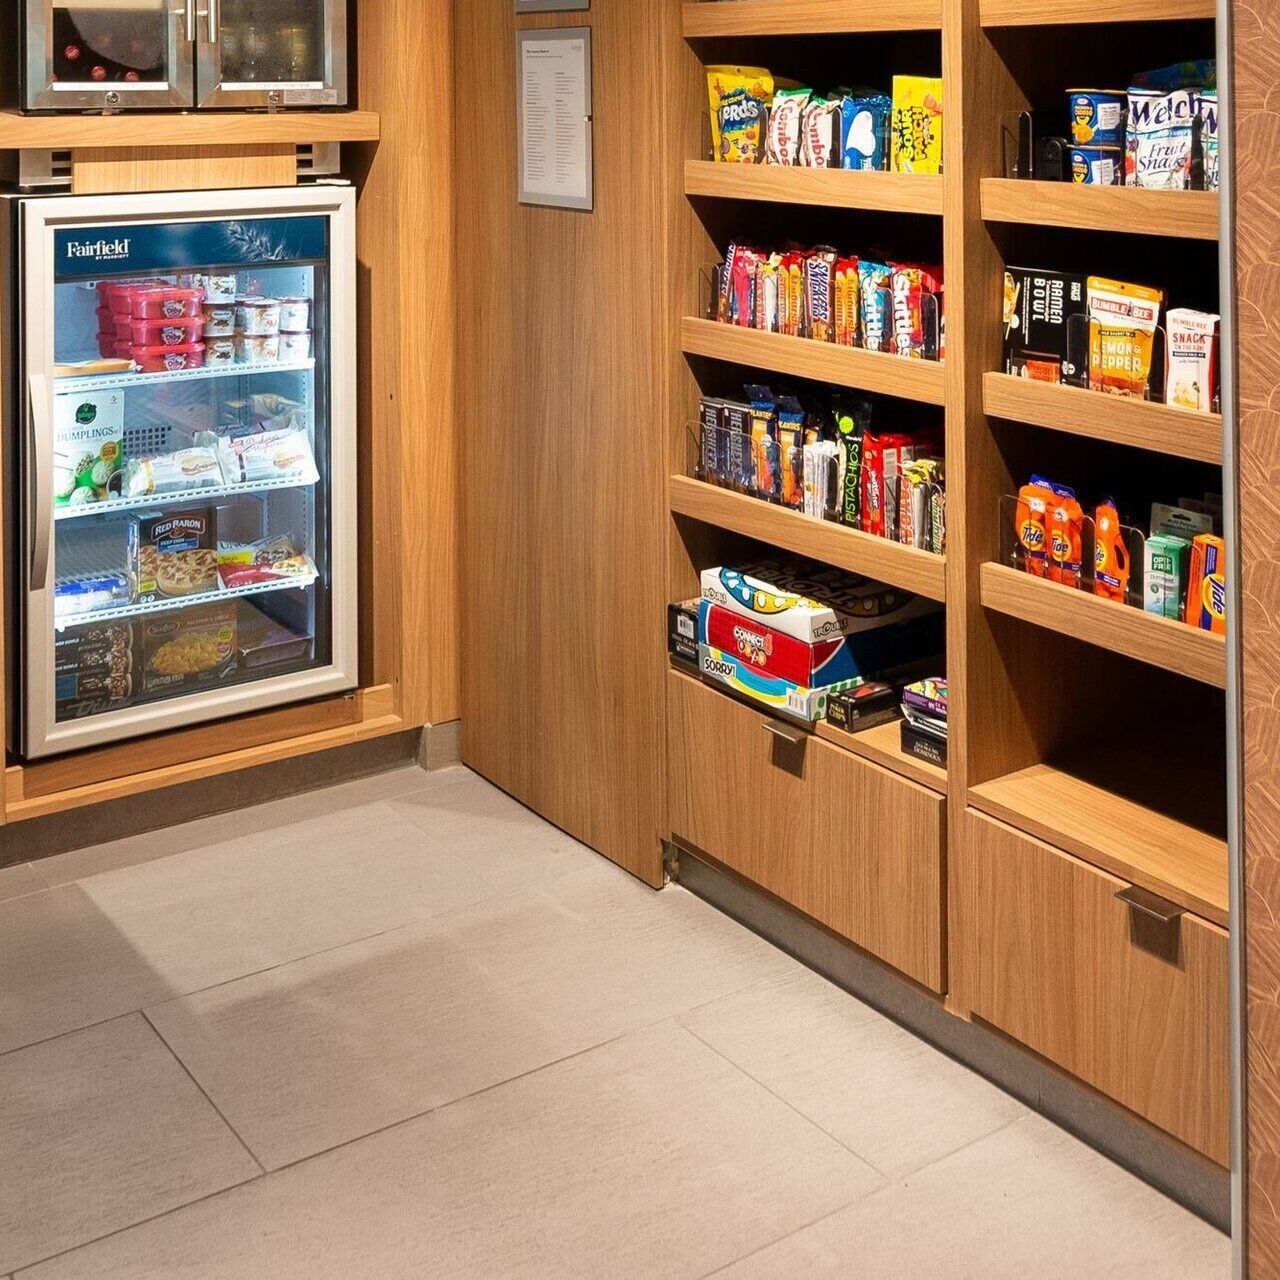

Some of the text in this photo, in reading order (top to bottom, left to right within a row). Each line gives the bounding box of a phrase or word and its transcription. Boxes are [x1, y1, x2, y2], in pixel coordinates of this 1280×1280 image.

[1131, 92, 1203, 126] Welch
[900, 109, 914, 158] SOUR
[913, 106, 926, 161] PATCH
[1149, 141, 1187, 158] Fruit
[67, 239, 130, 258] Fairfield
[818, 262, 829, 324] SNICKERS
[1032, 277, 1046, 322] BOWL
[1050, 279, 1064, 325] RAMEN
[1091, 297, 1151, 319] BUMBLE BEE
[1092, 341, 1131, 355] LEMON
[1173, 332, 1206, 345] SNACK
[1092, 354, 1142, 372] PEPPER
[57, 426, 114, 443] DUMPLINGS
[845, 442, 860, 523] PISTACHIOS
[154, 518, 201, 537] RED BARON
[1021, 524, 1045, 543] Tide
[1051, 536, 1069, 554] Tide
[1095, 548, 1105, 562] ide
[1207, 576, 1226, 615] Tide
[733, 627, 764, 649] CONNECT
[812, 618, 849, 639] TROUBLE
[704, 657, 737, 678] SORRY!
